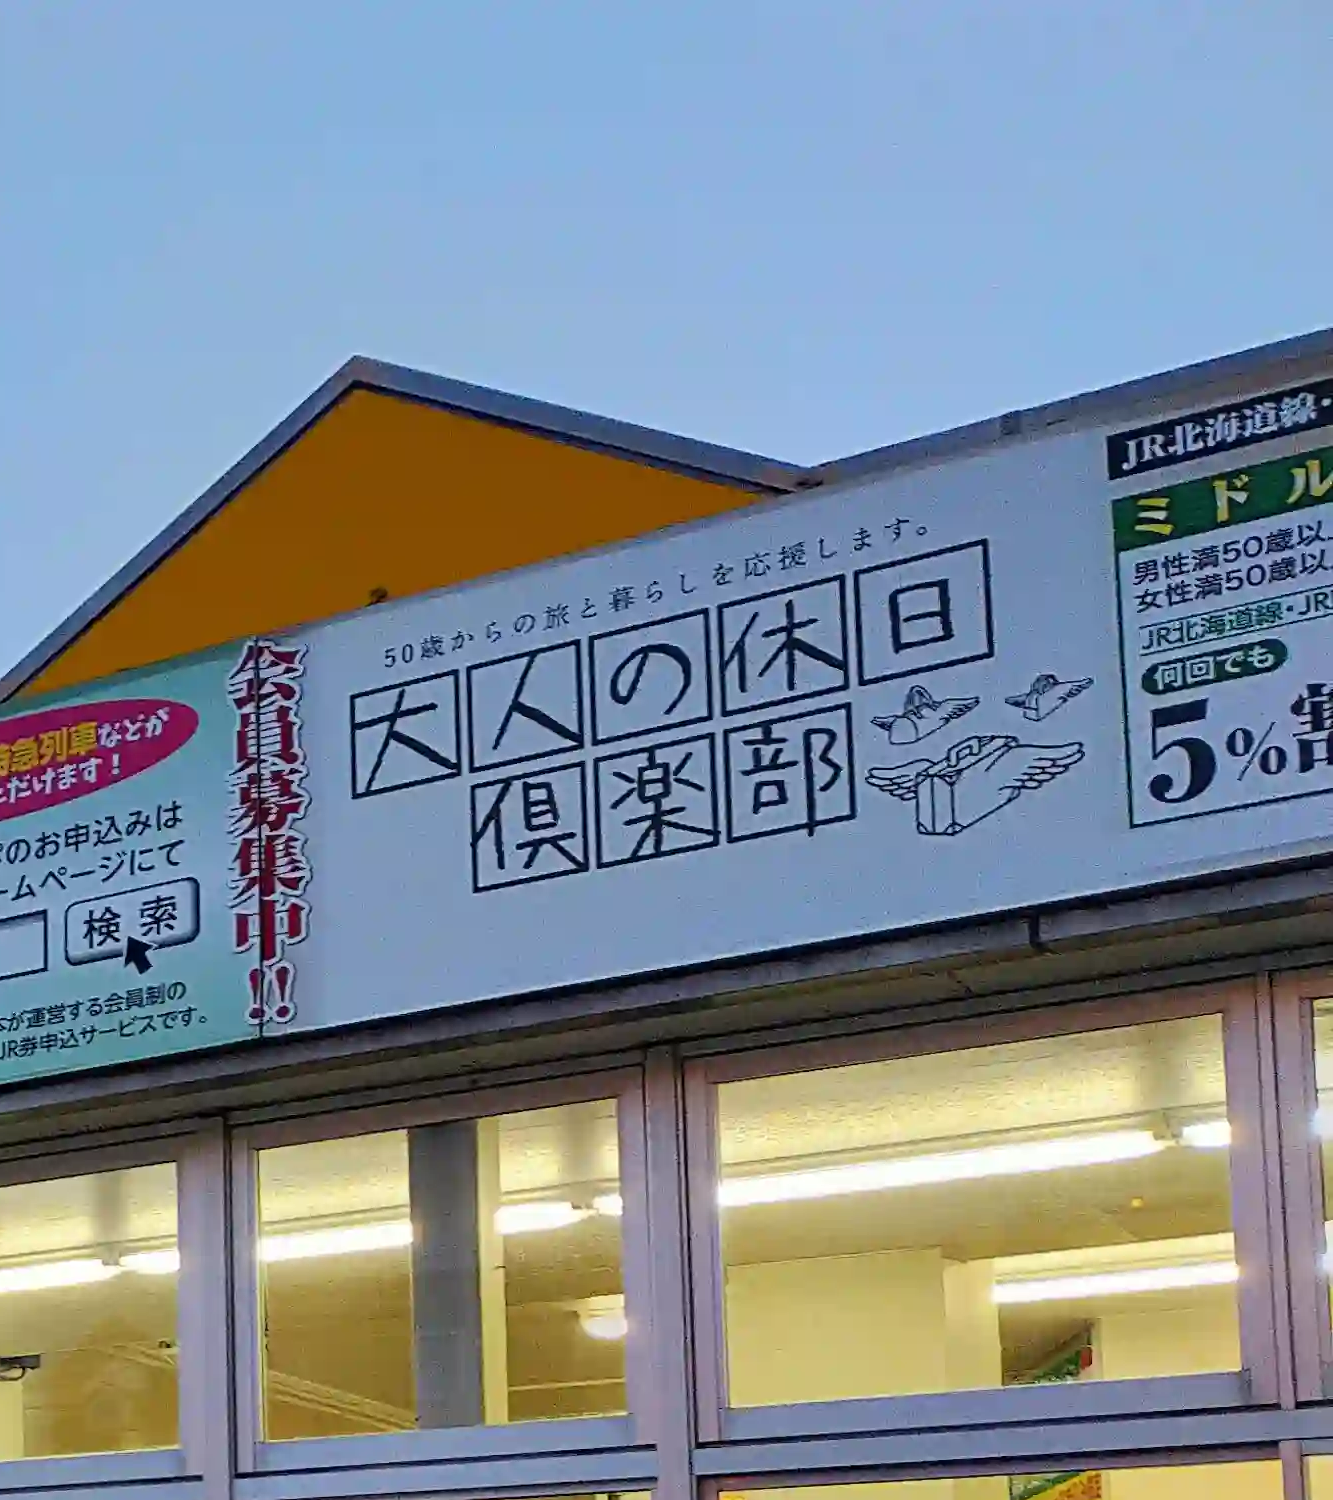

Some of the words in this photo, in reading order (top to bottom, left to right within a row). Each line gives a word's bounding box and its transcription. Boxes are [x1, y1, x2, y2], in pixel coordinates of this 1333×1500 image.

[1134, 520, 1333, 585] 男性満50歳以
[1134, 550, 1333, 613] 女性満50歳以
[383, 517, 928, 667] 50歳からの旅と暮らしを応援します。
[1142, 592, 1333, 649] JR北海道線・JR
[353, 578, 955, 794] 大人の休日
[1153, 646, 1274, 690] 何回でも
[473, 722, 845, 870] 倶楽部
[84, 895, 177, 948] 検索
